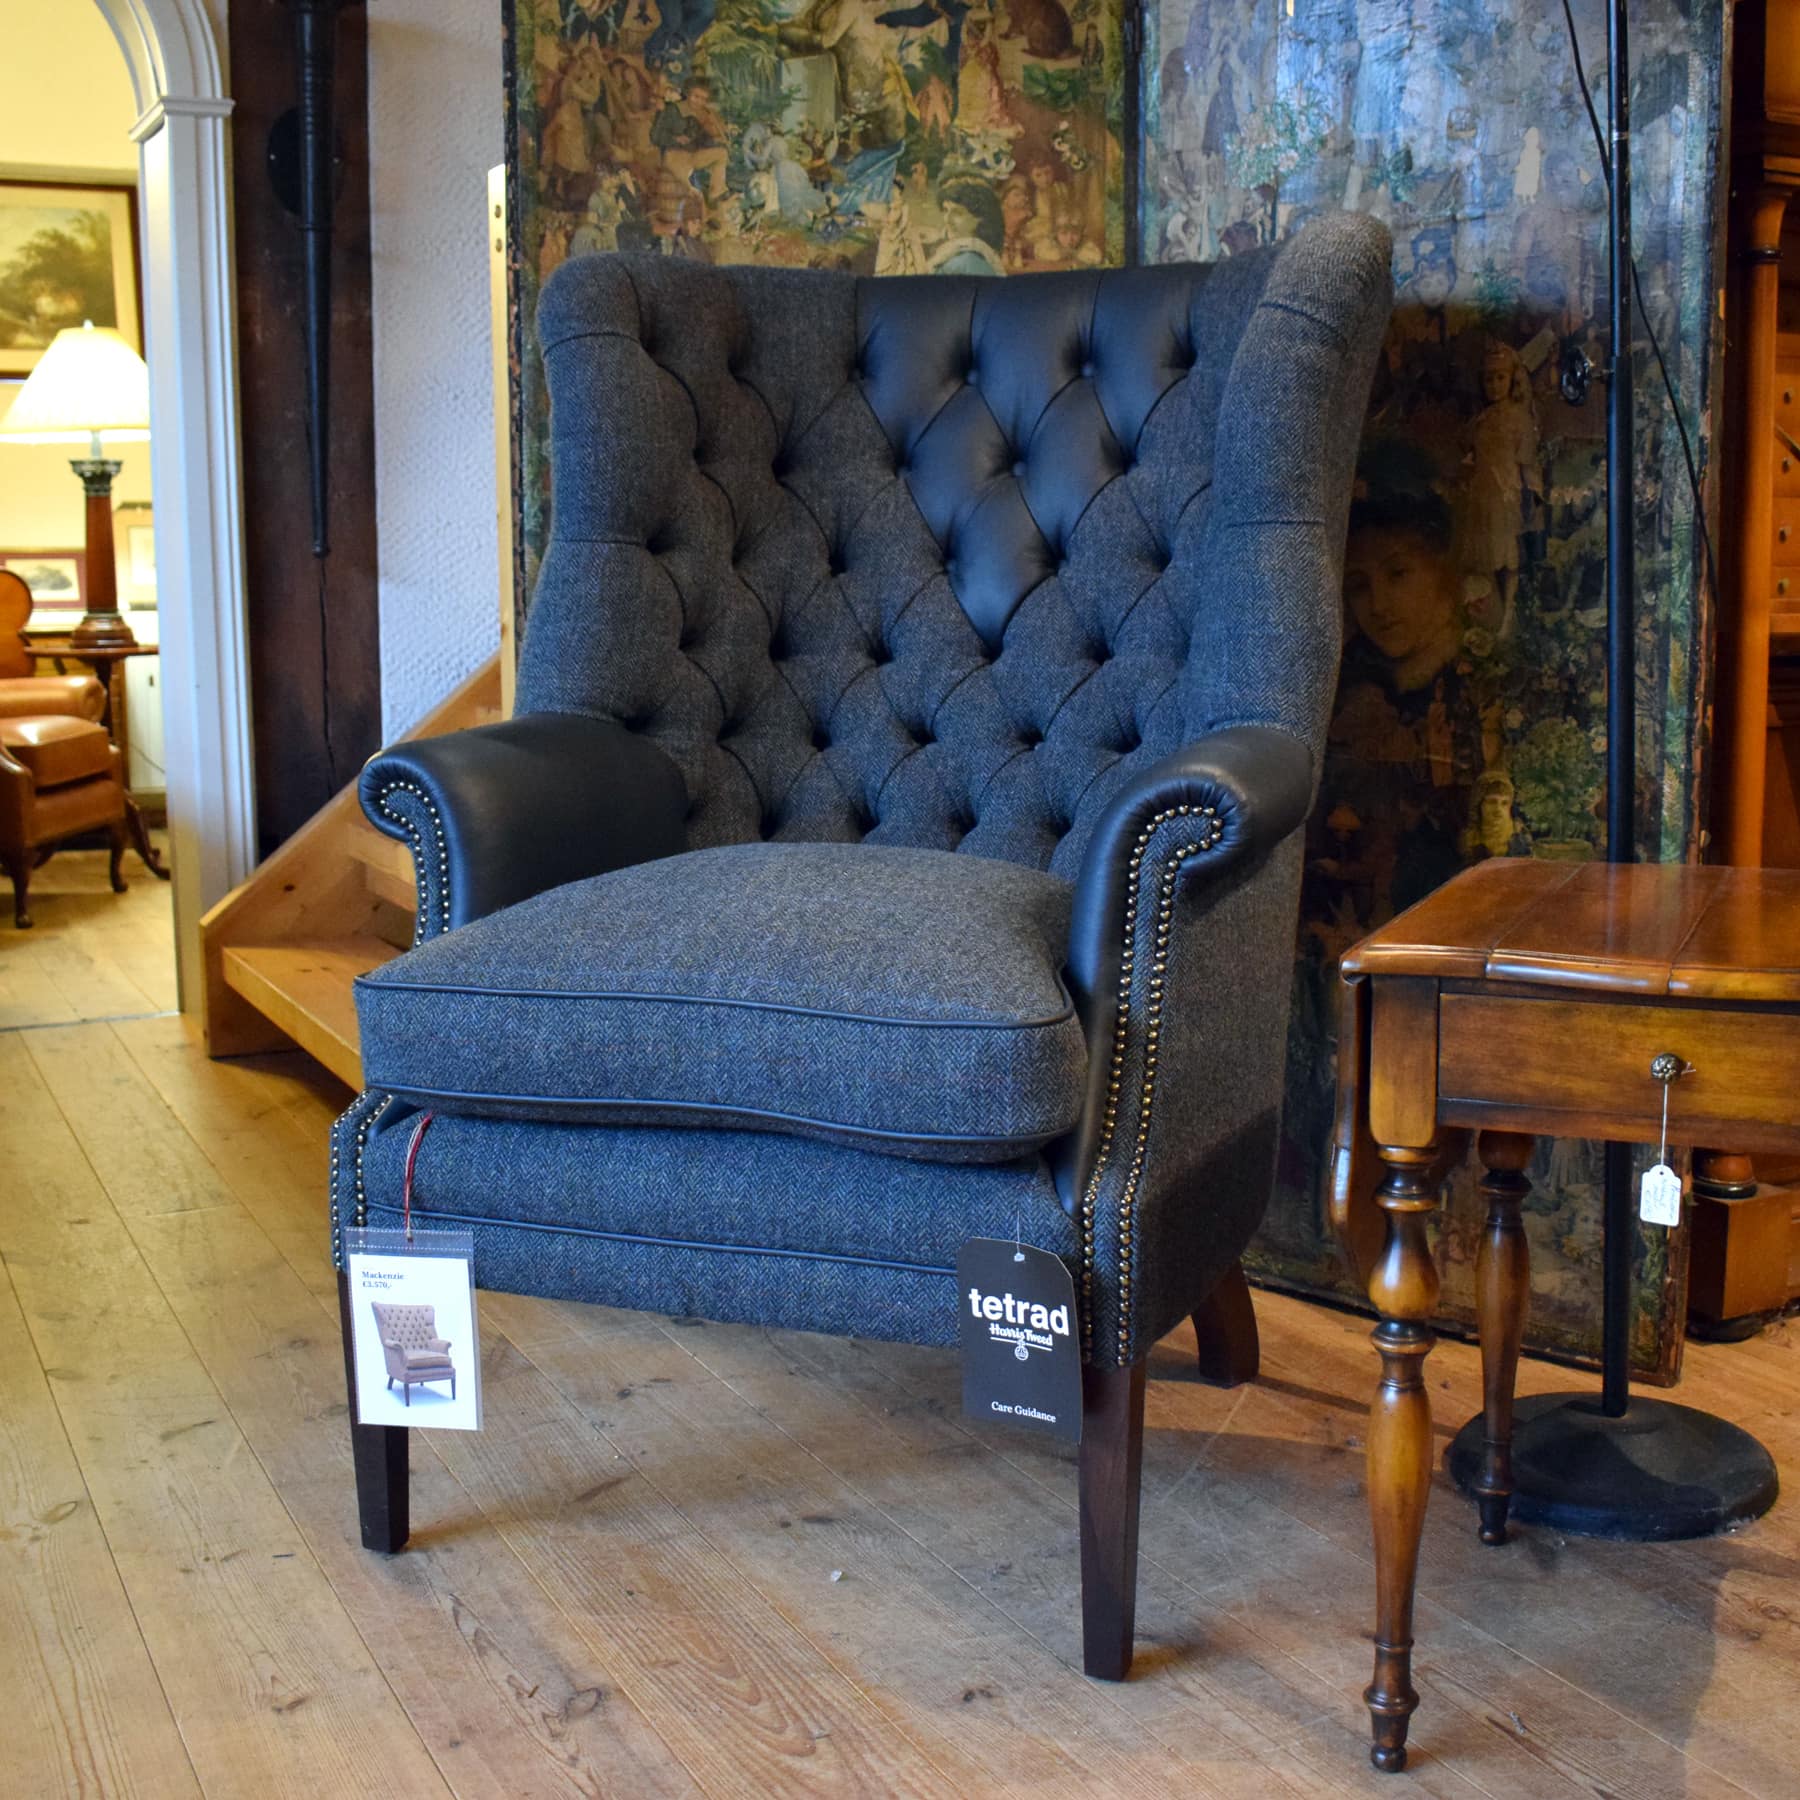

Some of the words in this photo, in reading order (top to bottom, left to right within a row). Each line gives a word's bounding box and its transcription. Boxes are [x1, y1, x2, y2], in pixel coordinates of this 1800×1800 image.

[361, 1271, 405, 1280] Mackenzie
[968, 1288, 1069, 1336] tetrad
[991, 1401, 1013, 1414] Care
[1014, 1405, 1057, 1423] Guidance
